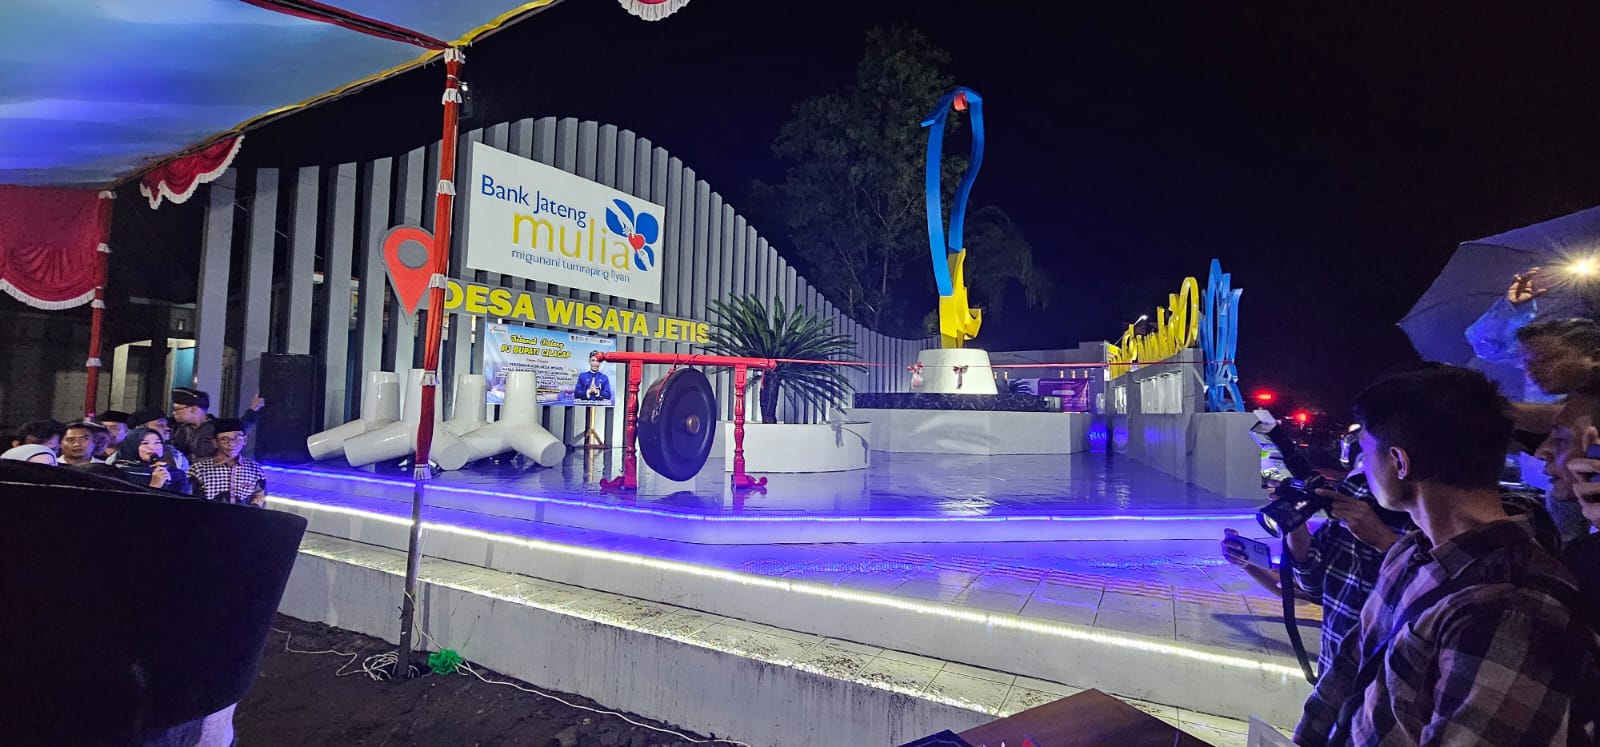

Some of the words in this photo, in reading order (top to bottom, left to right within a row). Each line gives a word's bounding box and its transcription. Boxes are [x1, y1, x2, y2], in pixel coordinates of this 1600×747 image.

[481, 174, 530, 206] Bank
[534, 190, 586, 228] Jateng
[511, 249, 560, 265] migunani
[562, 260, 609, 280] tumraping
[512, 213, 630, 271] mulia
[444, 281, 535, 320] DESA
[545, 297, 649, 336] WISATA
[654, 316, 710, 343] JETIS
